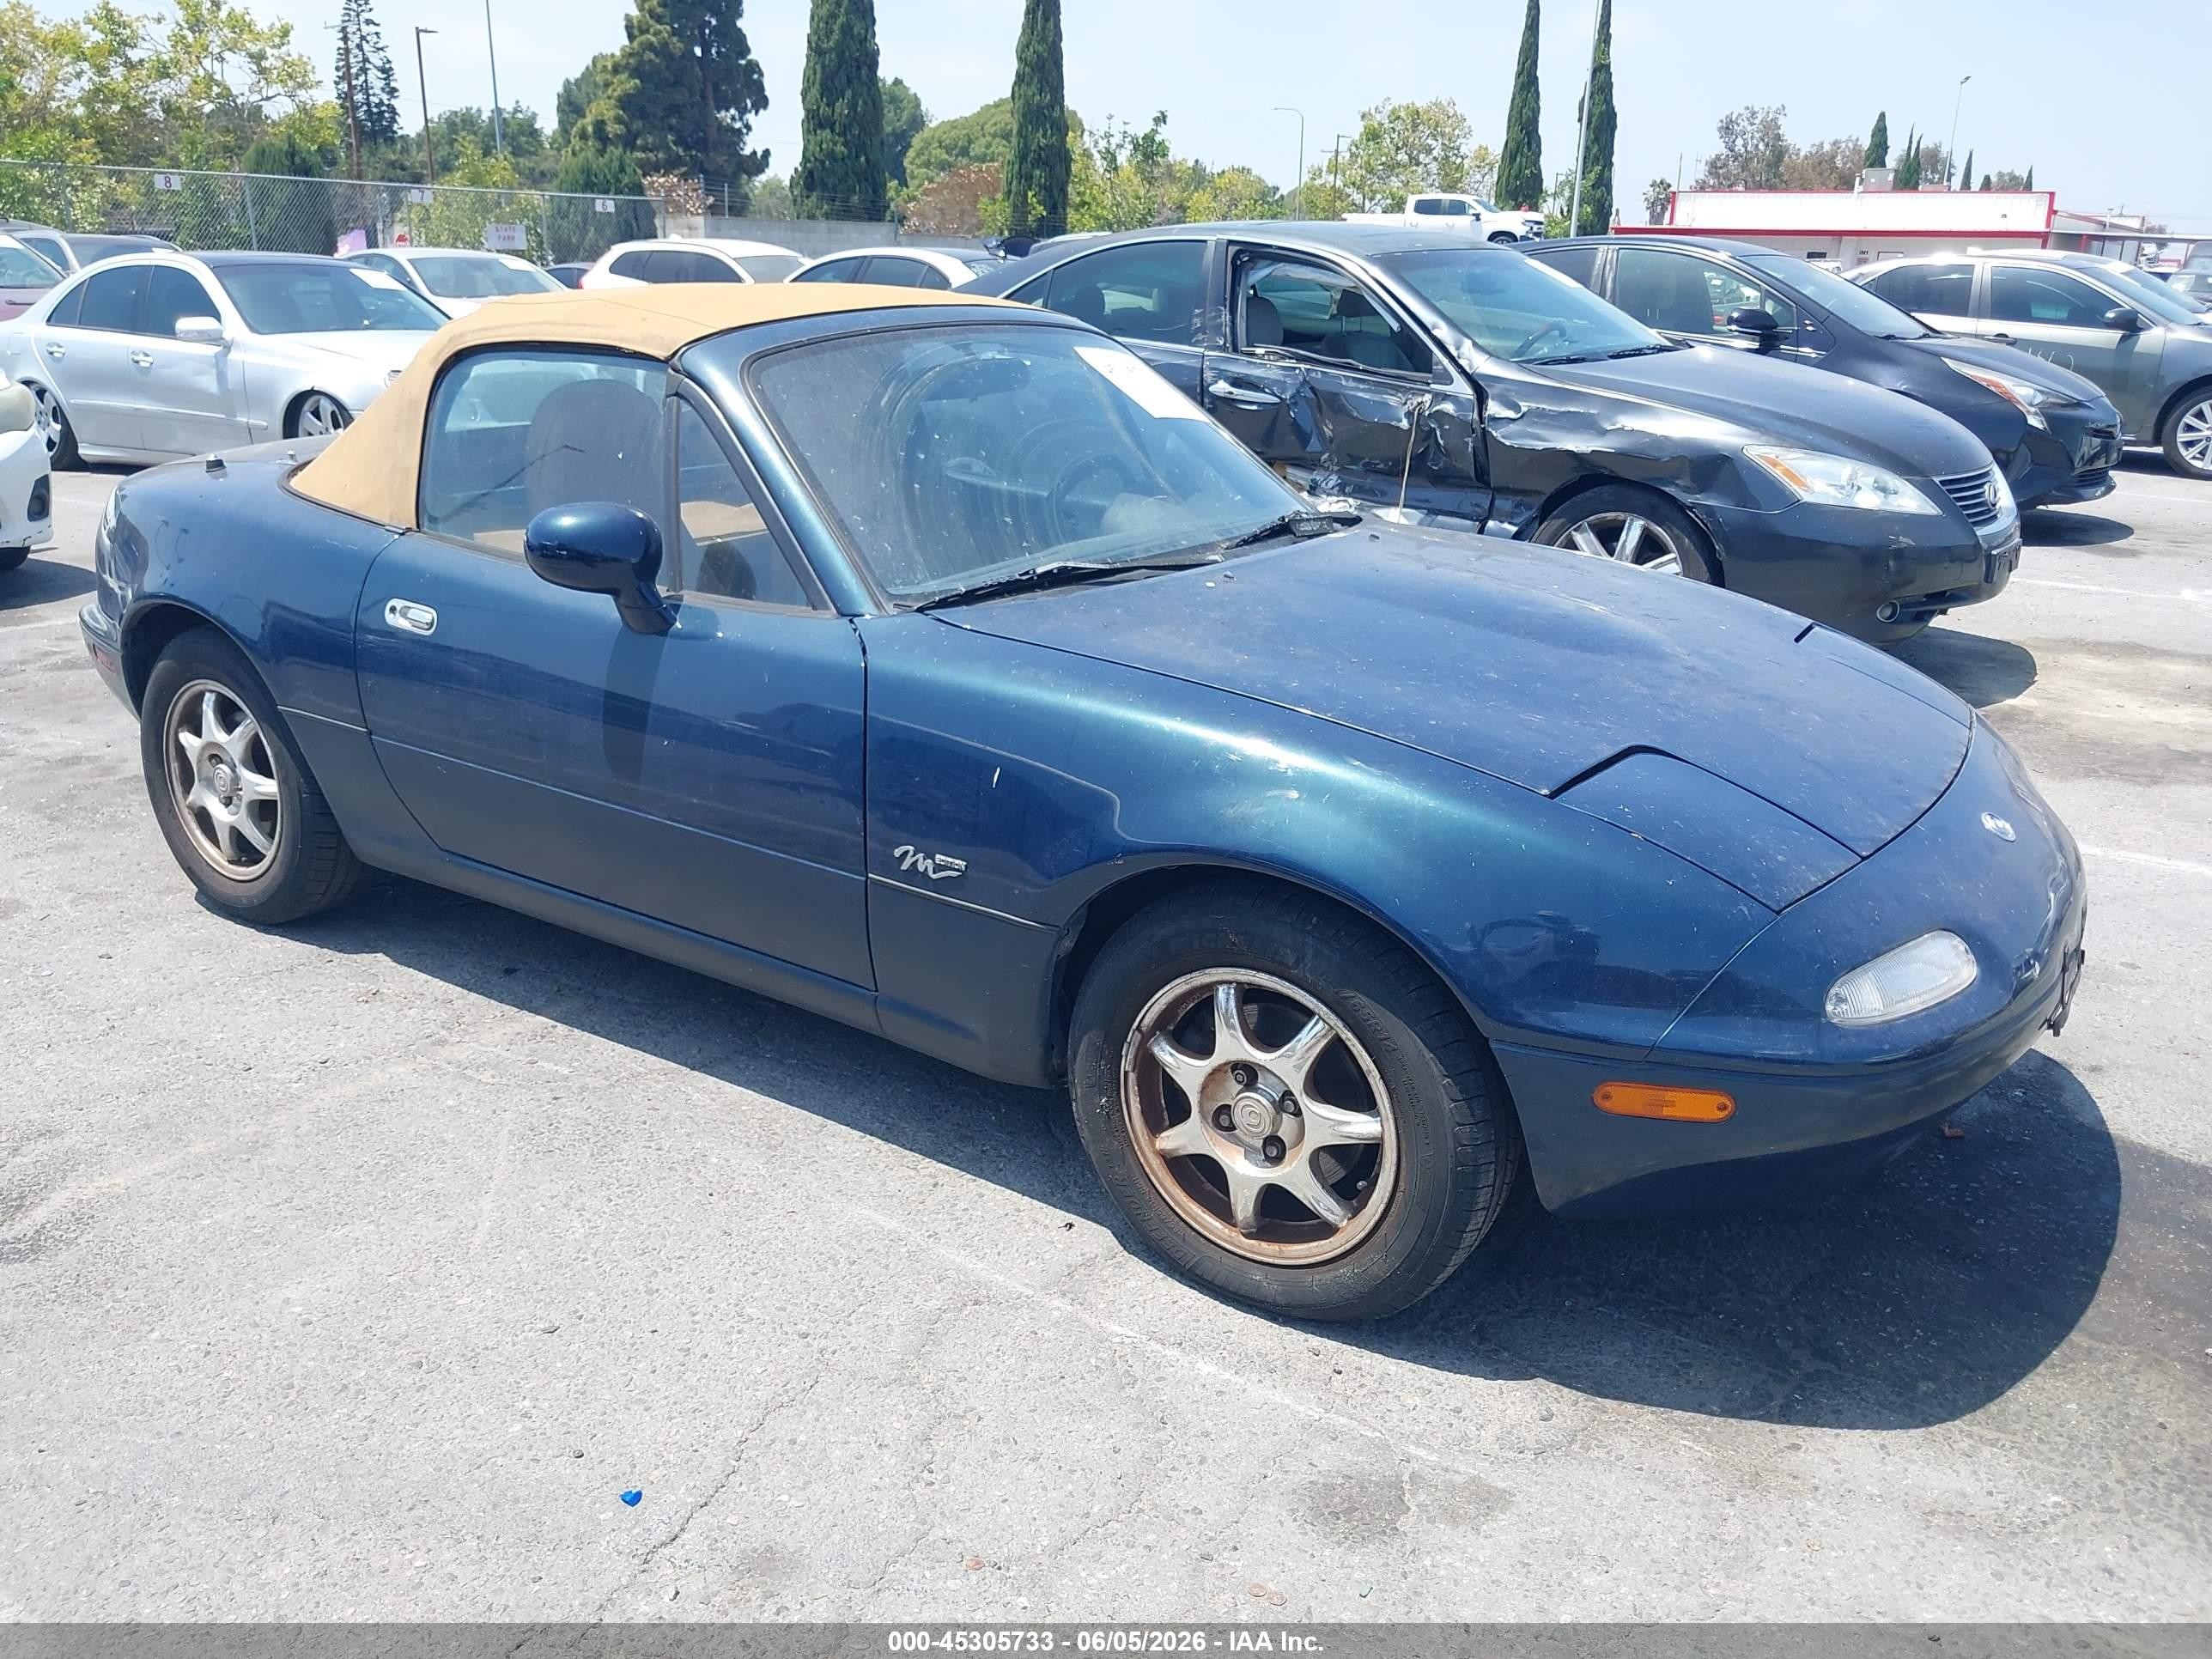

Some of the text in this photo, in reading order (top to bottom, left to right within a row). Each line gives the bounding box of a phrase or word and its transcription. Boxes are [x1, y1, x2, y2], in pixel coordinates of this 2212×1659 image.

[164, 175, 173, 189] 8
[418, 190, 426, 202] 7
[601, 200, 609, 211] 6
